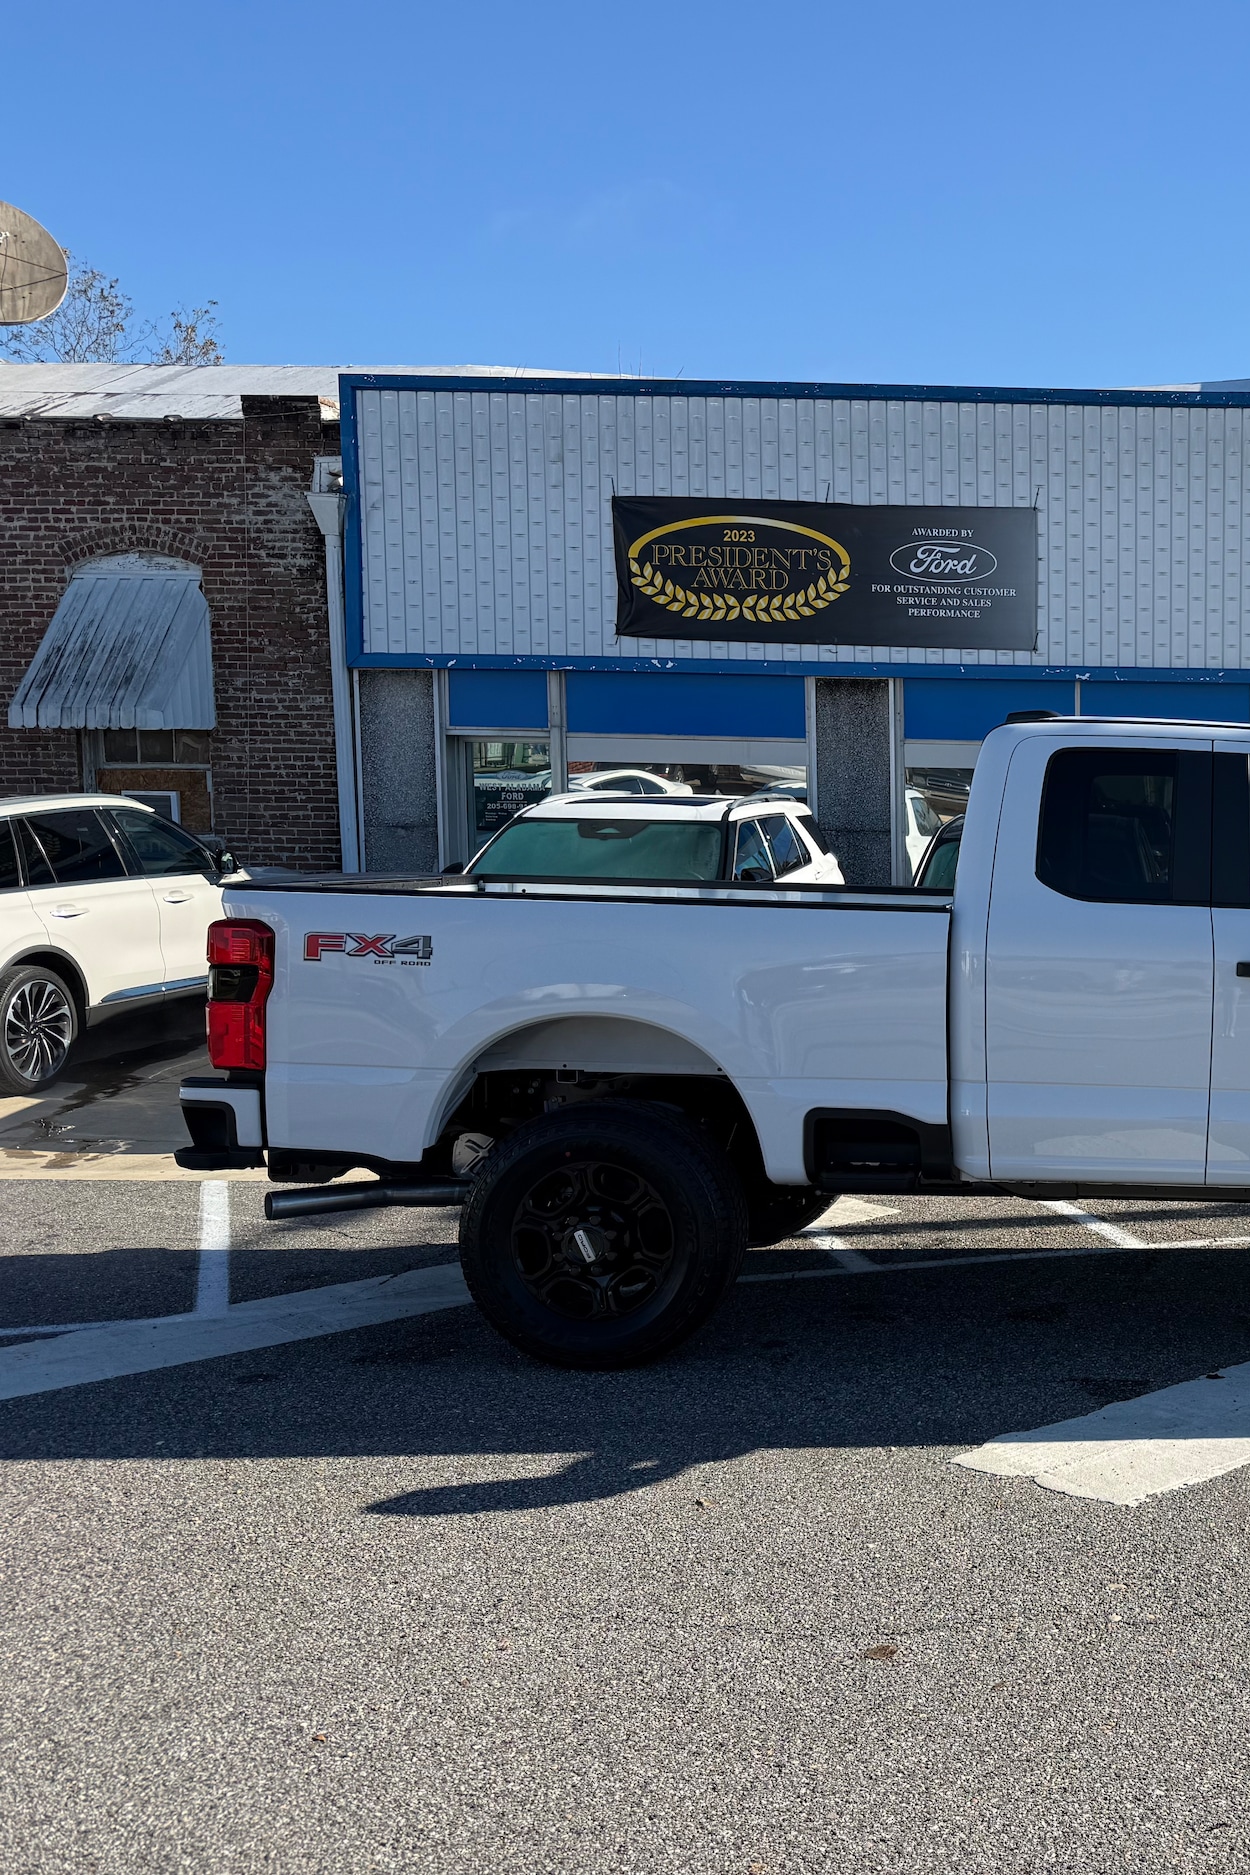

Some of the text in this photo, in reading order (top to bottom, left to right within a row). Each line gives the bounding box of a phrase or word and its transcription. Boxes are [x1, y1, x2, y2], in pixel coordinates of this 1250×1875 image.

[723, 529, 756, 542] 2023
[911, 528, 974, 538] AWARDED BY
[651, 544, 832, 571] PRESIDENT'S
[909, 545, 977, 574] Ford
[690, 567, 789, 590] AWARD
[871, 584, 1017, 597] FOR OUTSTANDING CUSTOMER
[896, 596, 992, 608] SERVICE AND SALES
[908, 607, 981, 619] PERFORMANCE
[479, 782, 546, 792] WEST ALABAMA
[501, 792, 524, 800] FORD
[303, 931, 433, 962] FX4
